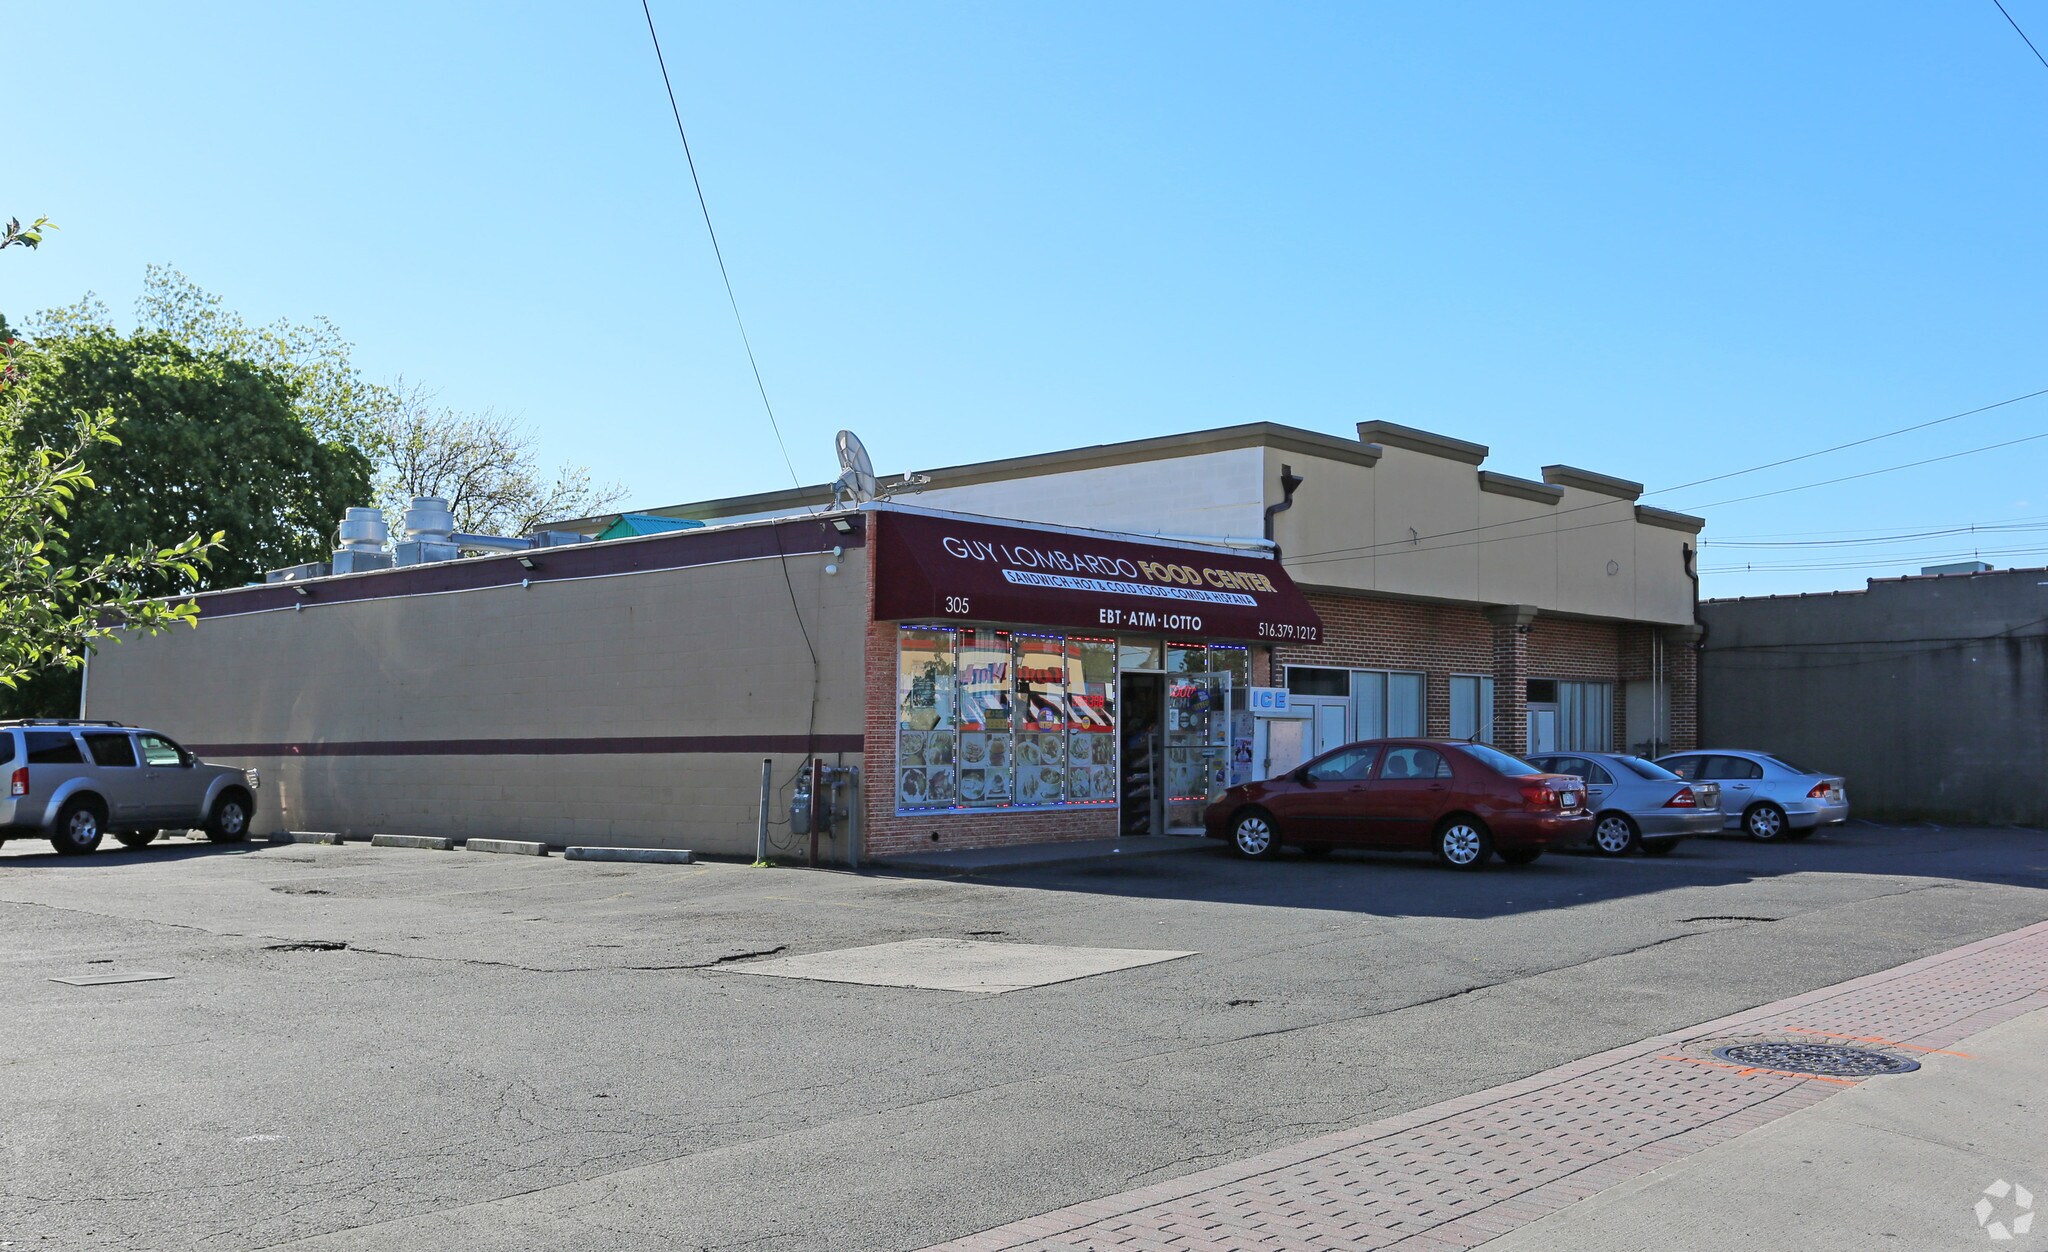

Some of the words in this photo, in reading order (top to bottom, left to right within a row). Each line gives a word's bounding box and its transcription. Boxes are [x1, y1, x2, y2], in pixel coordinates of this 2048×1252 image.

[943, 537, 998, 563] GUY
[1001, 544, 1138, 578] LOMBARDO
[1137, 560, 1203, 586] FOOD
[1203, 567, 1278, 593] CENTER
[1096, 581, 1107, 591] &
[1106, 582, 1137, 594] COLD
[1211, 592, 1254, 606] HISPANA
[945, 596, 970, 614] 305
[1099, 608, 1121, 625] EBT
[1128, 611, 1156, 627] ATM
[1163, 614, 1202, 631] LOTTO
[1258, 622, 1317, 640] 516.379.1212
[1253, 691, 1287, 709] ICE
